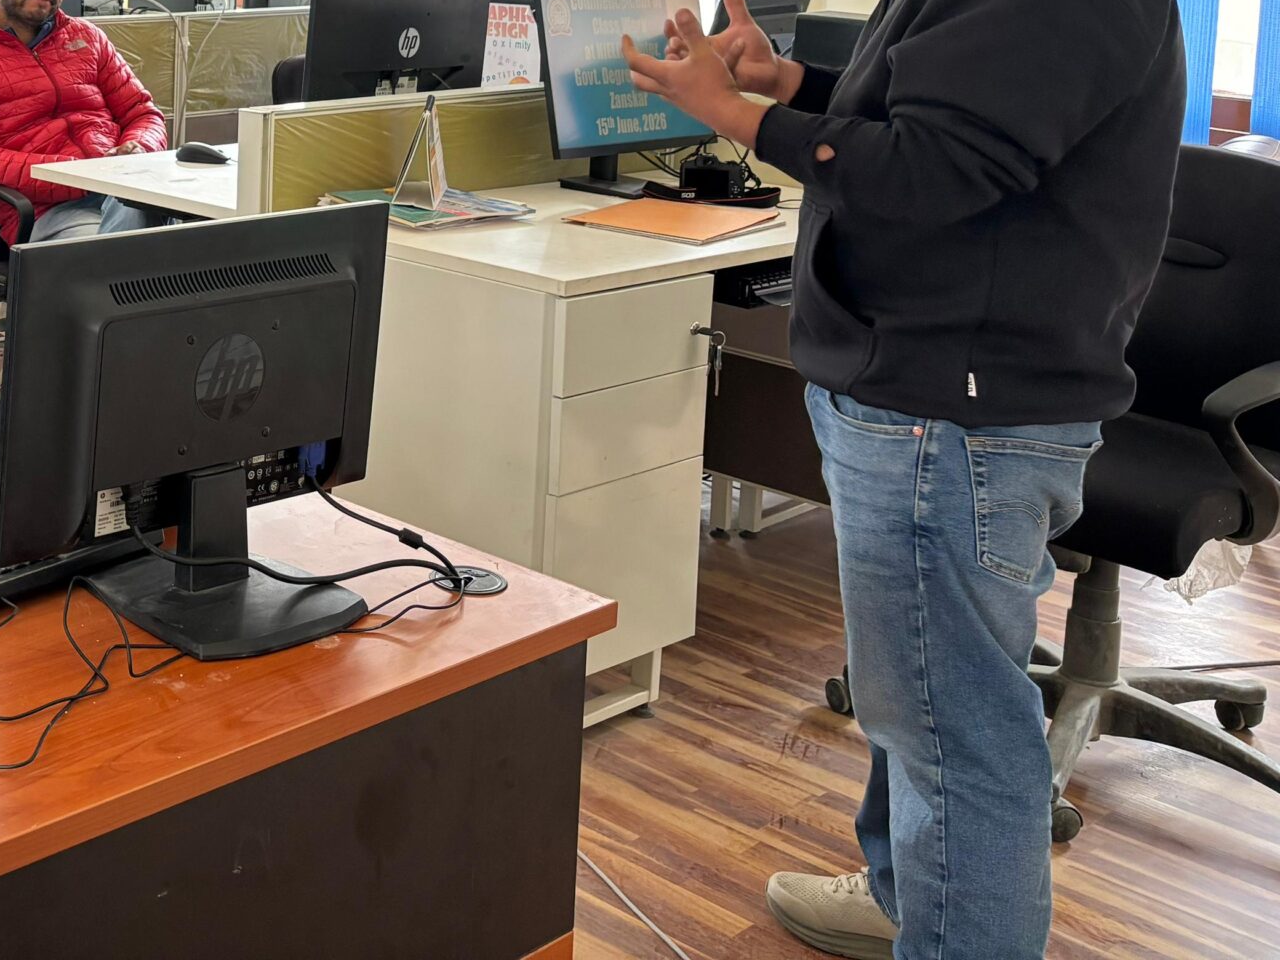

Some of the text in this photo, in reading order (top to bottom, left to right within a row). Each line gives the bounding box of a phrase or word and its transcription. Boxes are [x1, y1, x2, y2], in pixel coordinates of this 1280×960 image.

[487, 21, 528, 38] ESIGN
[400, 27, 418, 58] hp
[493, 40, 531, 51] oximity
[574, 67, 631, 86] Govt. Degre
[609, 90, 648, 109] Zanskar
[596, 113, 667, 136] 15th June, 2026
[201, 334, 259, 420] hp
